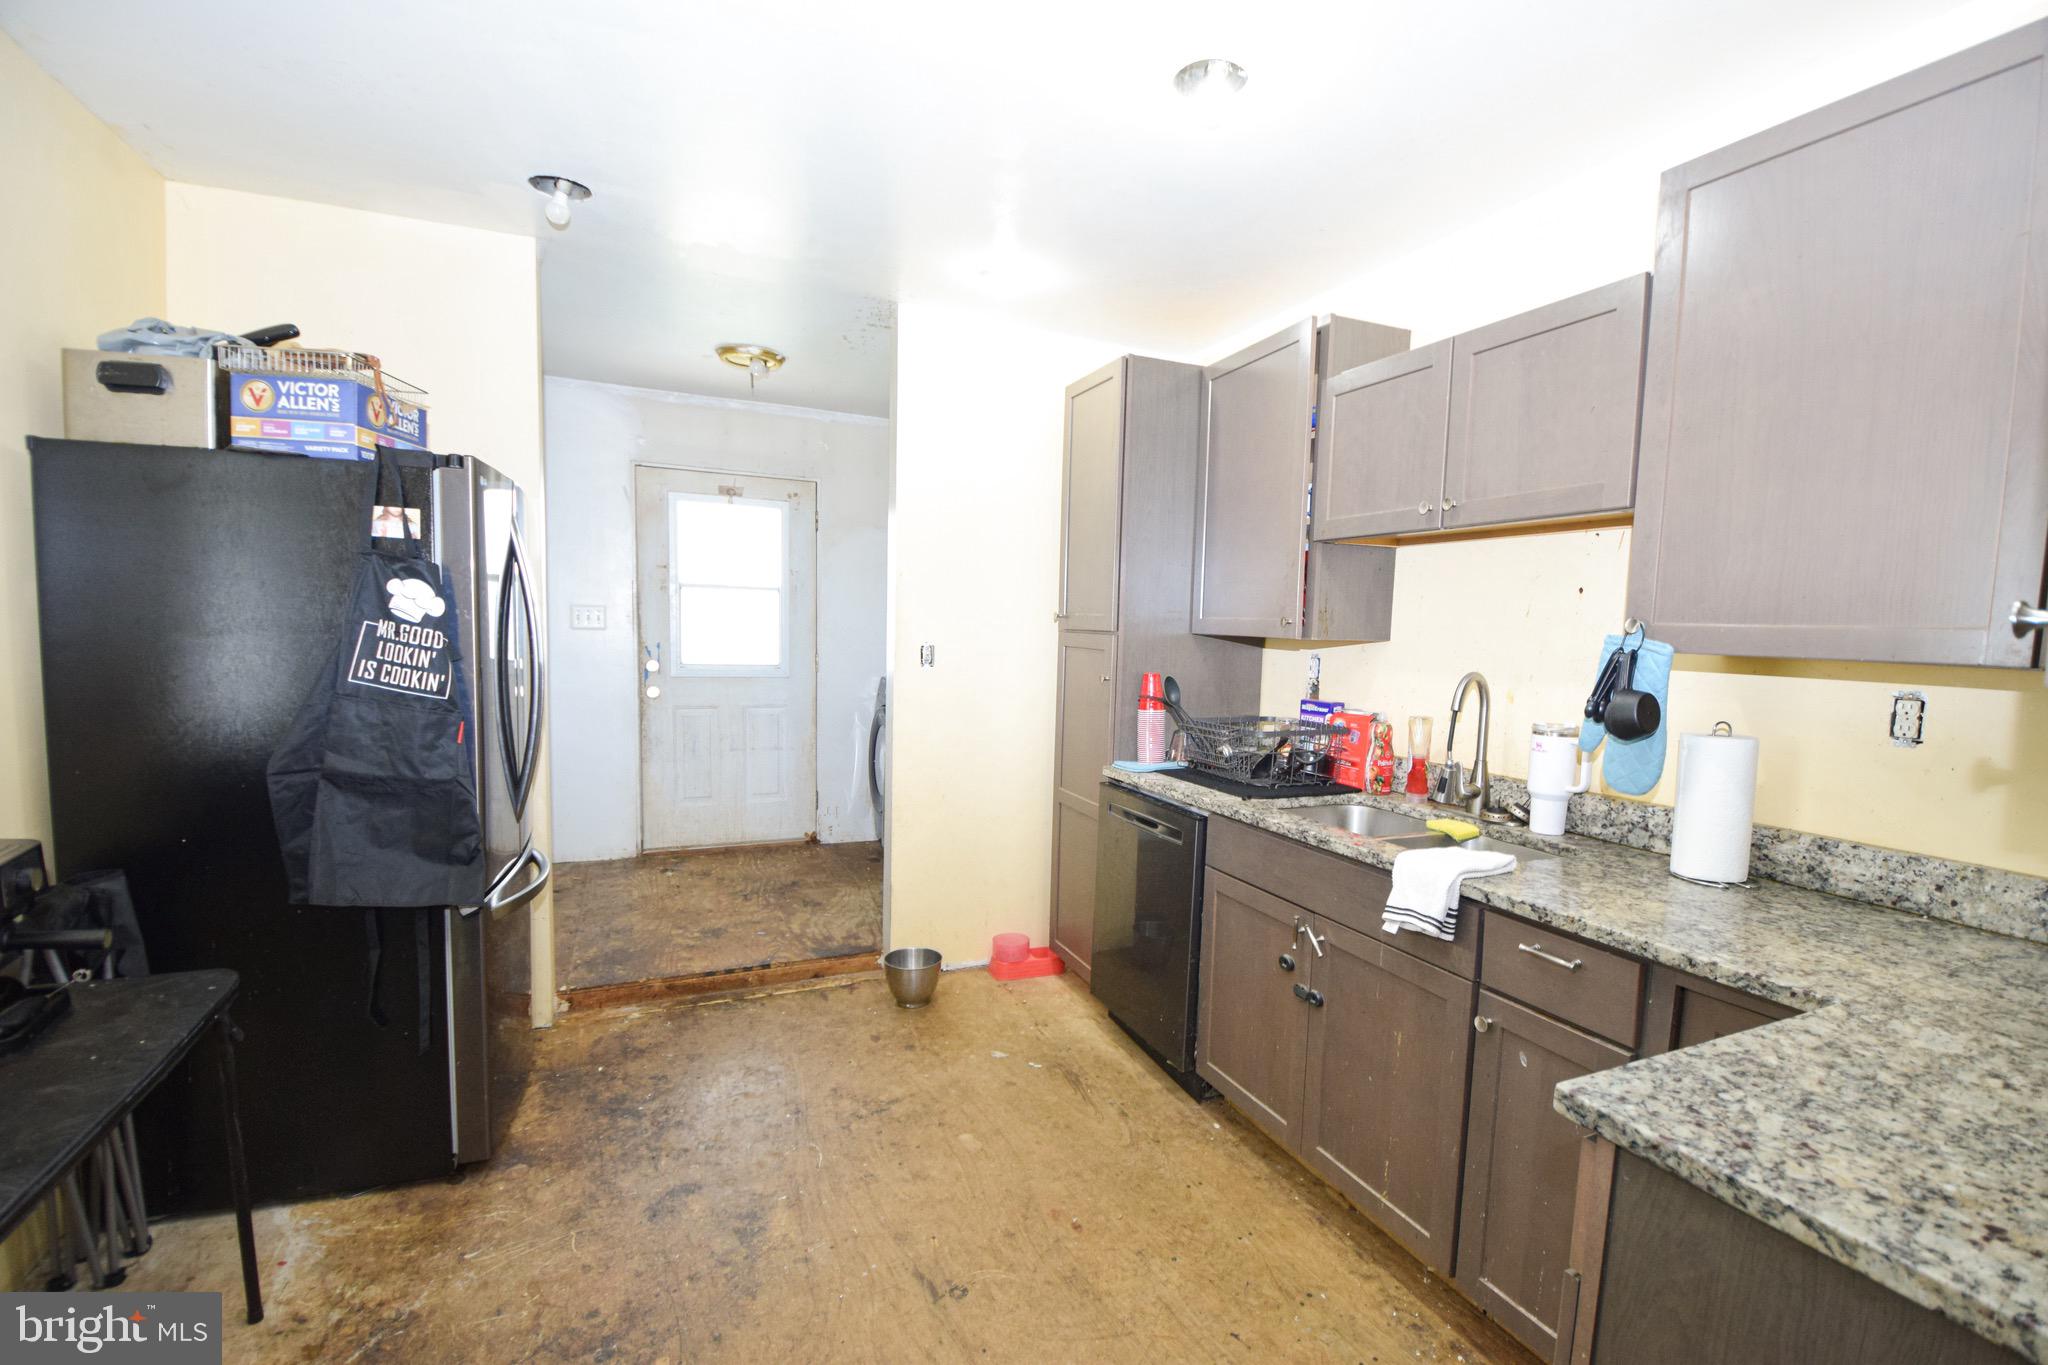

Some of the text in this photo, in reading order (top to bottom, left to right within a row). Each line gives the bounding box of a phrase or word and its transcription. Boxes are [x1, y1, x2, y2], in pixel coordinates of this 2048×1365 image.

[277, 380, 340, 397] VICTOR
[277, 395, 340, 413] ALLEN'S
[376, 641, 437, 669] LOOKIN'
[357, 659, 446, 692] IS COOKIN'
